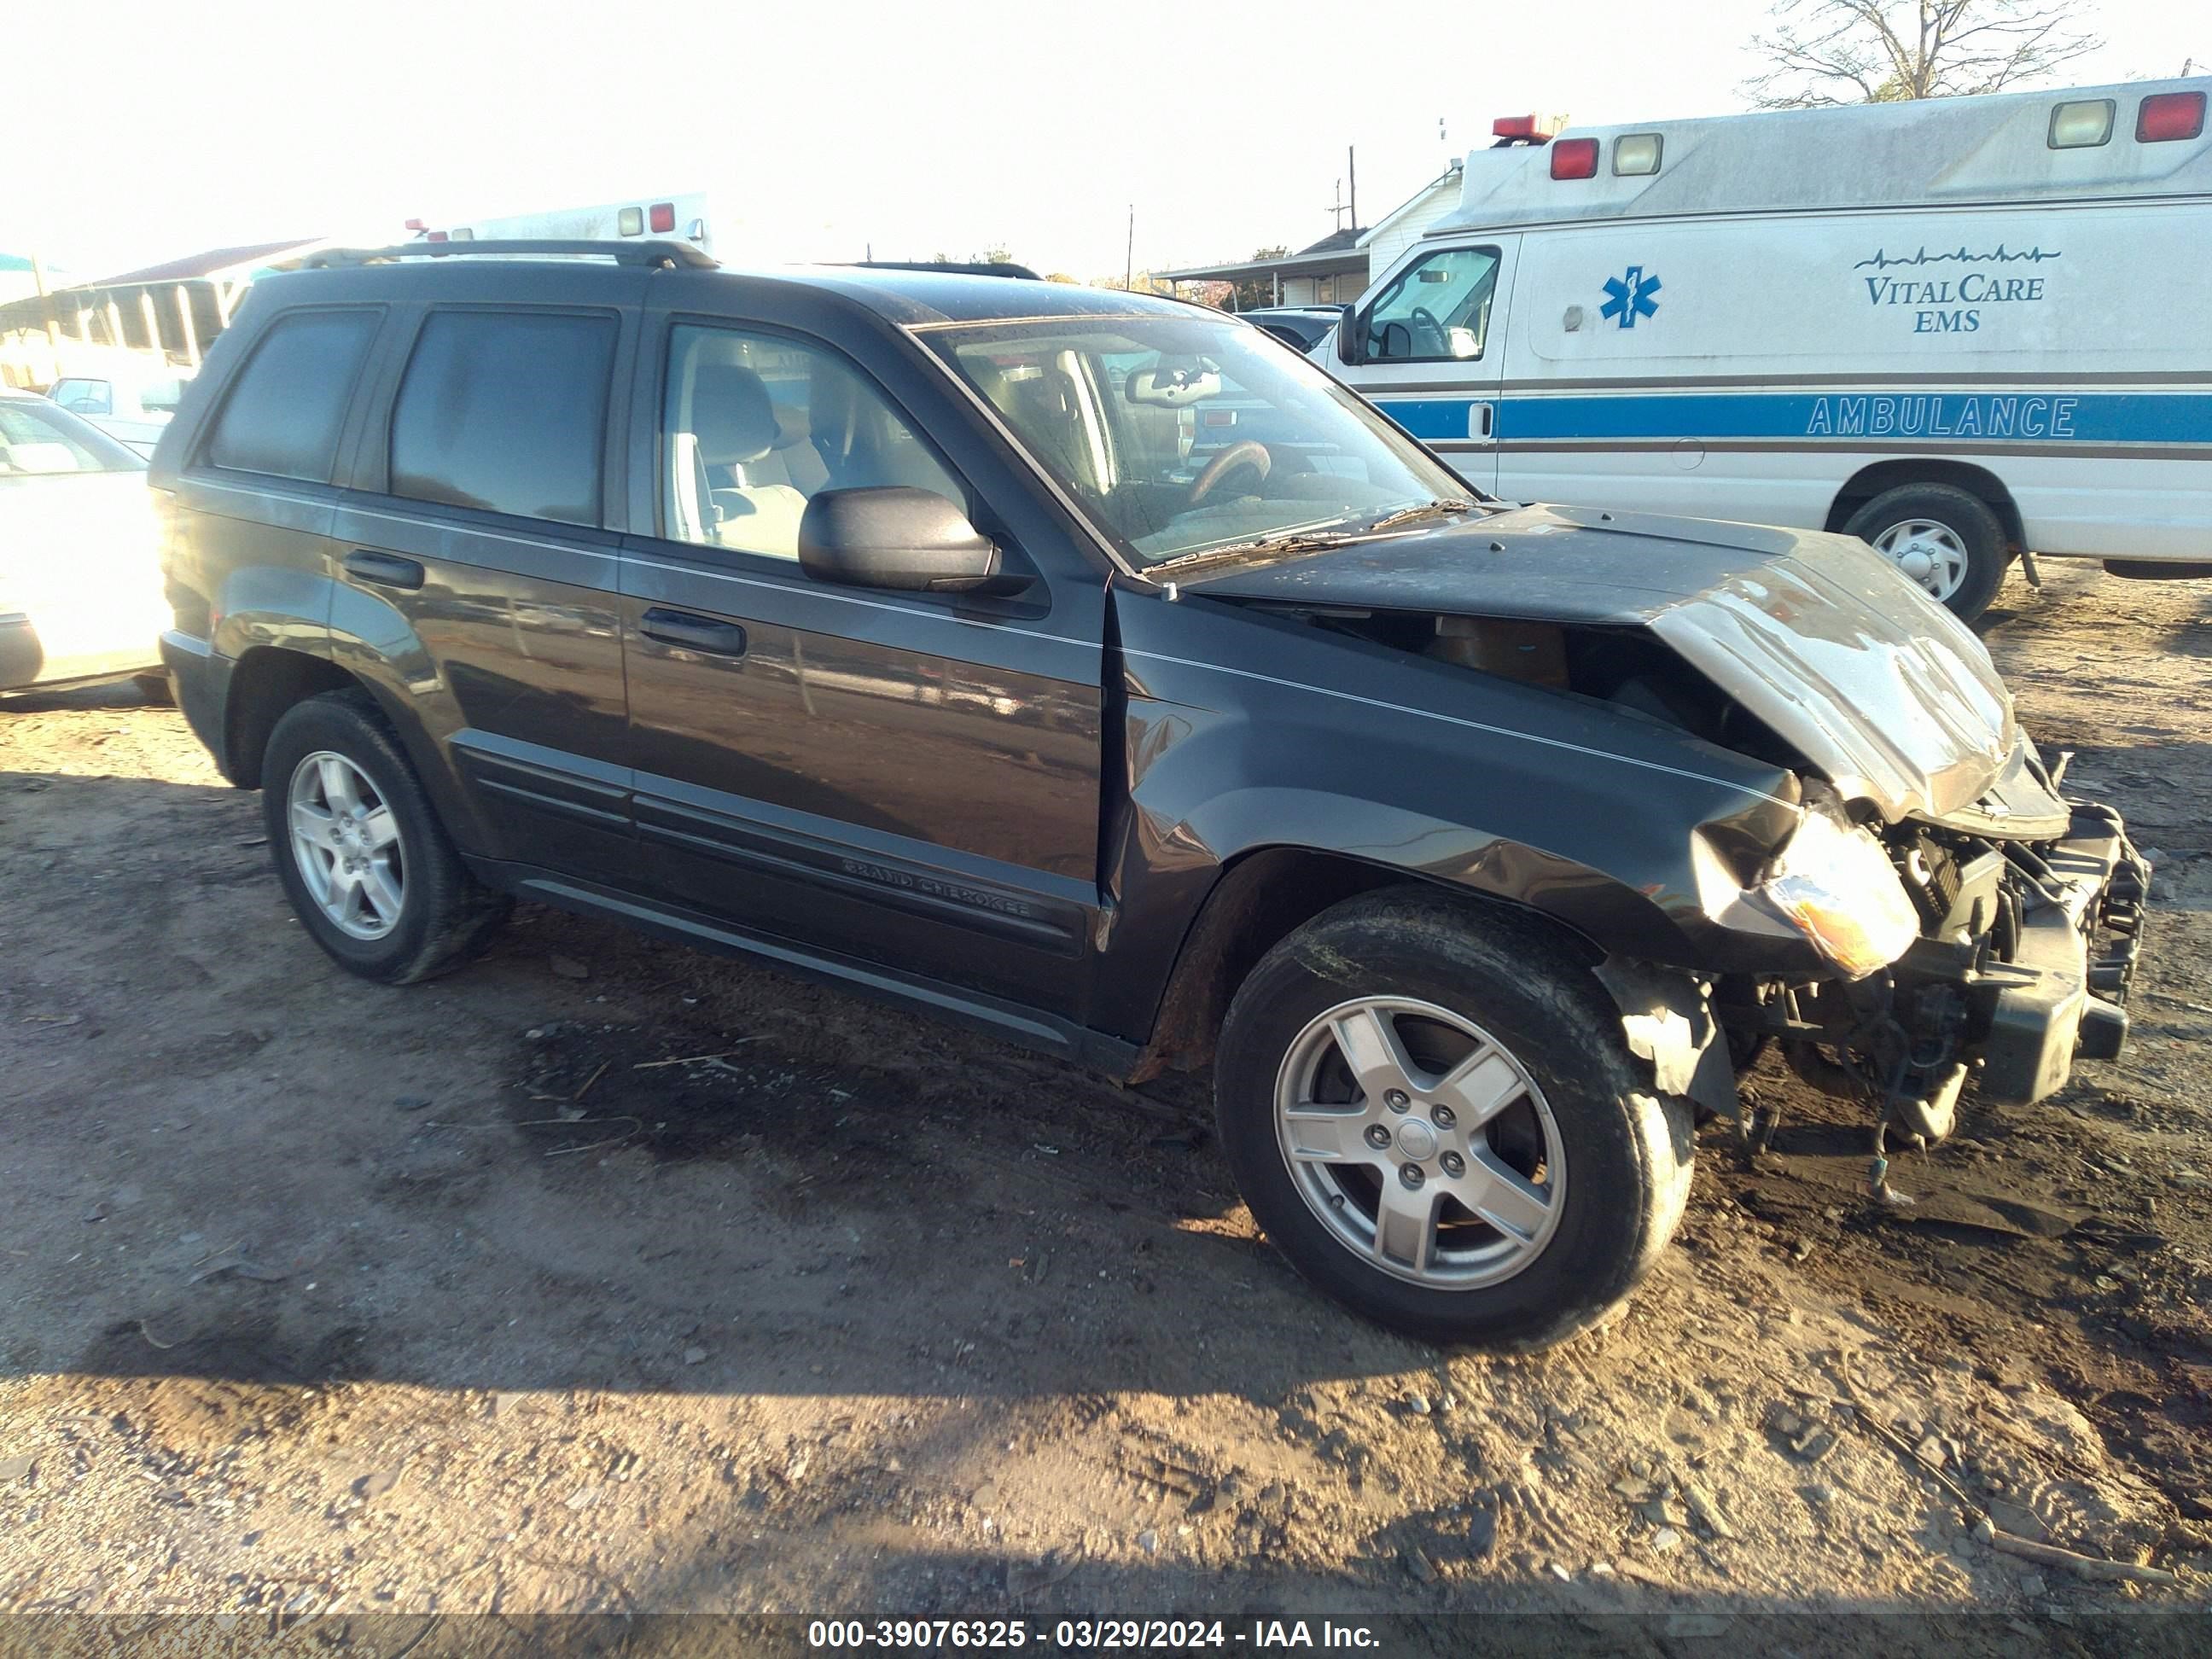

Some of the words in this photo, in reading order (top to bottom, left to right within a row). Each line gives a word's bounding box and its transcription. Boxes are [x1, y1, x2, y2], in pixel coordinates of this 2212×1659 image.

[1913, 309, 1980, 333] EMS
[1807, 397, 2078, 436] AMBULANCE
[841, 858, 914, 888] GRAND
[918, 877, 1031, 917] CHEROKEE
